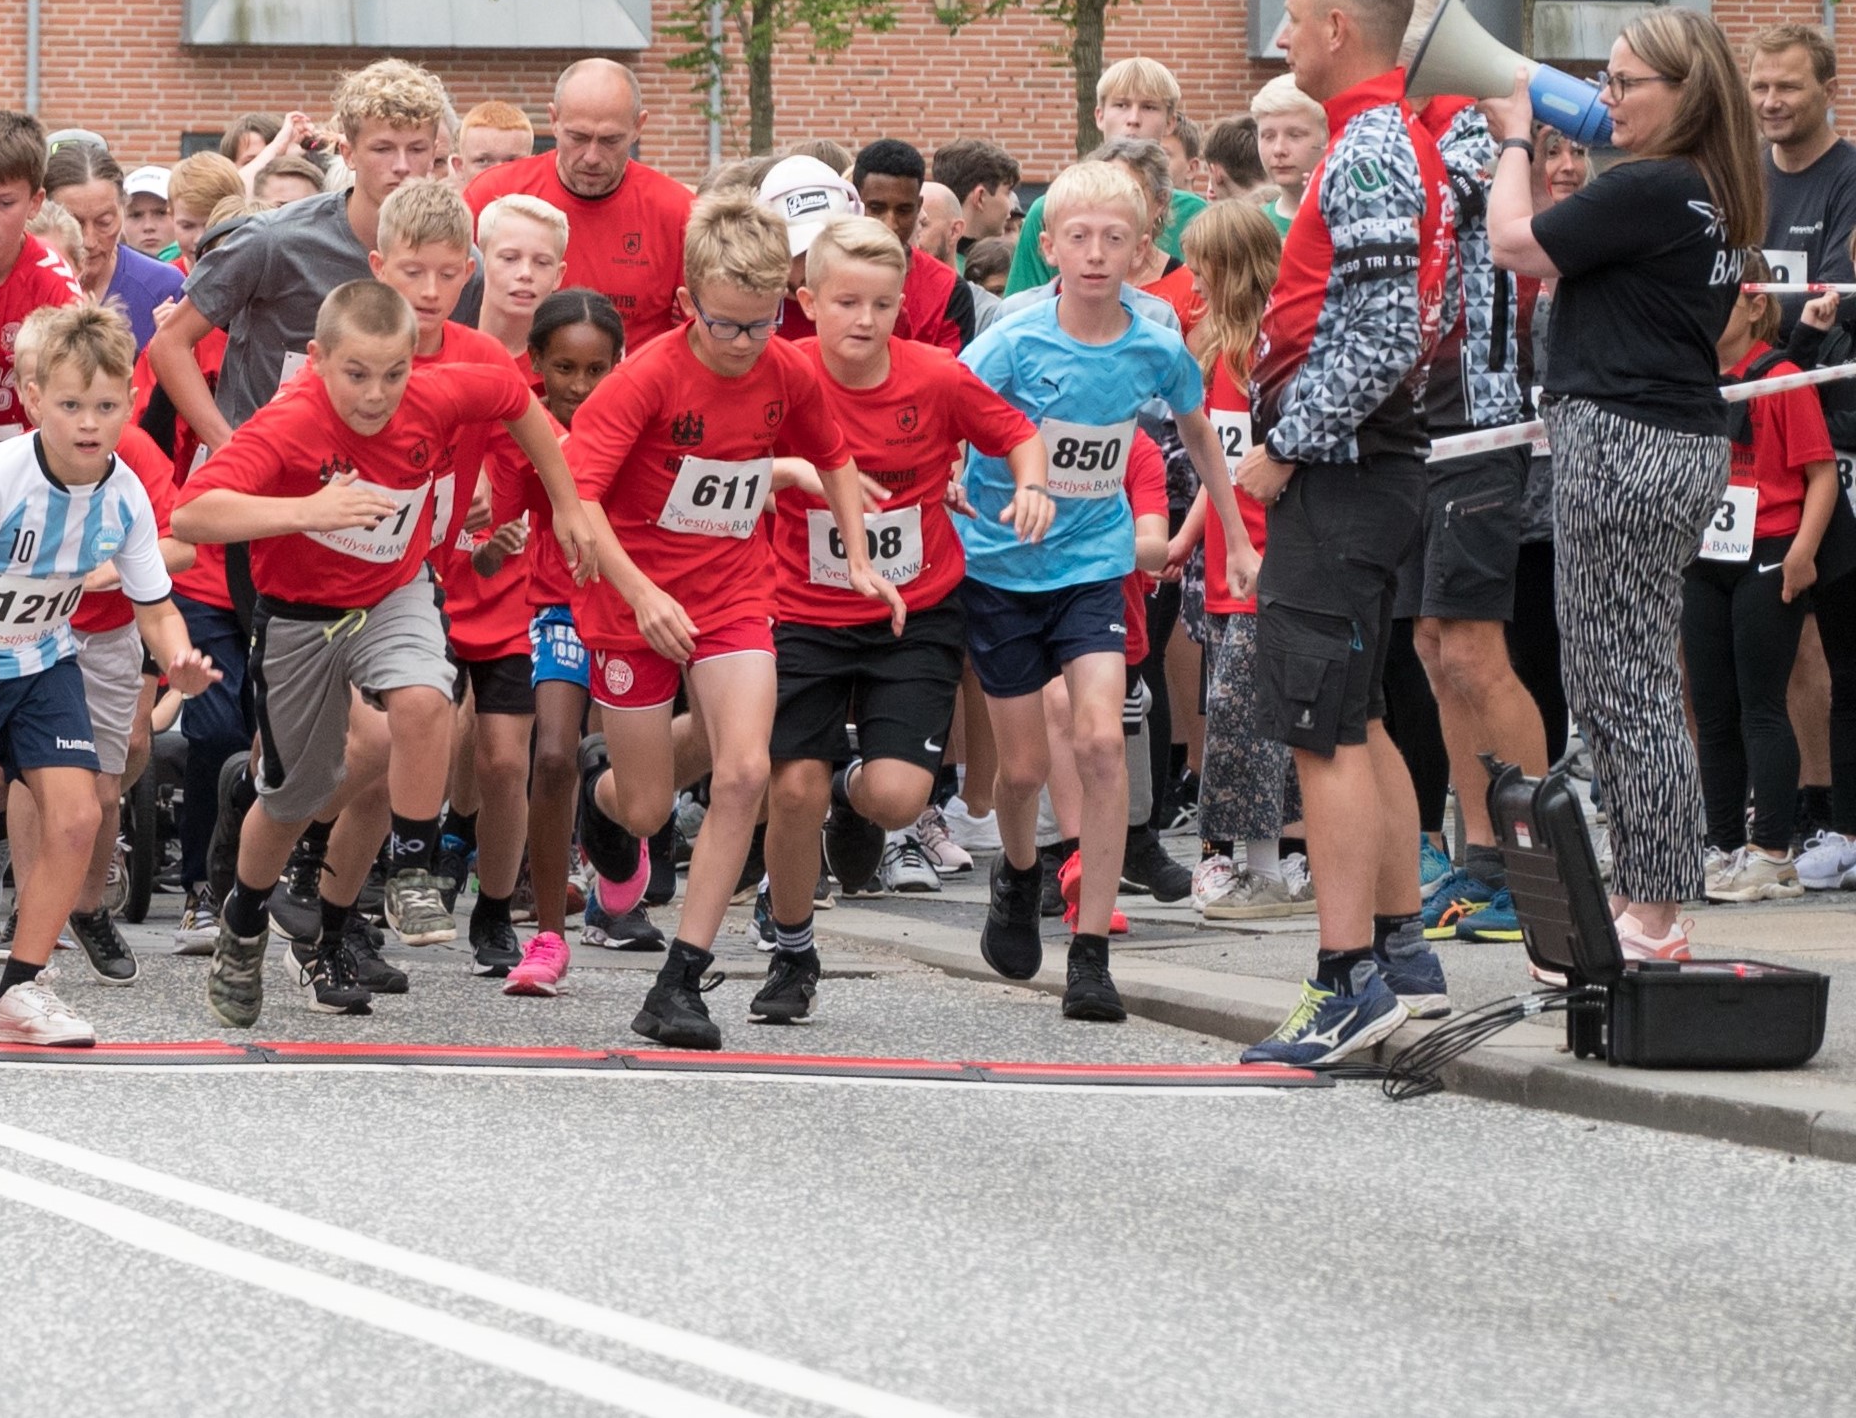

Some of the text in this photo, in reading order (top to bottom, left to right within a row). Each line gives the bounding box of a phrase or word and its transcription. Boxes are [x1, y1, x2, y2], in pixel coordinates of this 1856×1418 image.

[788, 194, 828, 215] Puma
[1365, 255, 1387, 269] TRI
[1404, 255, 1420, 267] TR
[1052, 437, 1122, 471] 850
[691, 474, 760, 510] 611
[677, 516, 757, 533] vestjyskBAN
[9, 528, 36, 563] 10
[319, 531, 407, 556] vestjyskBAN
[545, 624, 582, 644] REM
